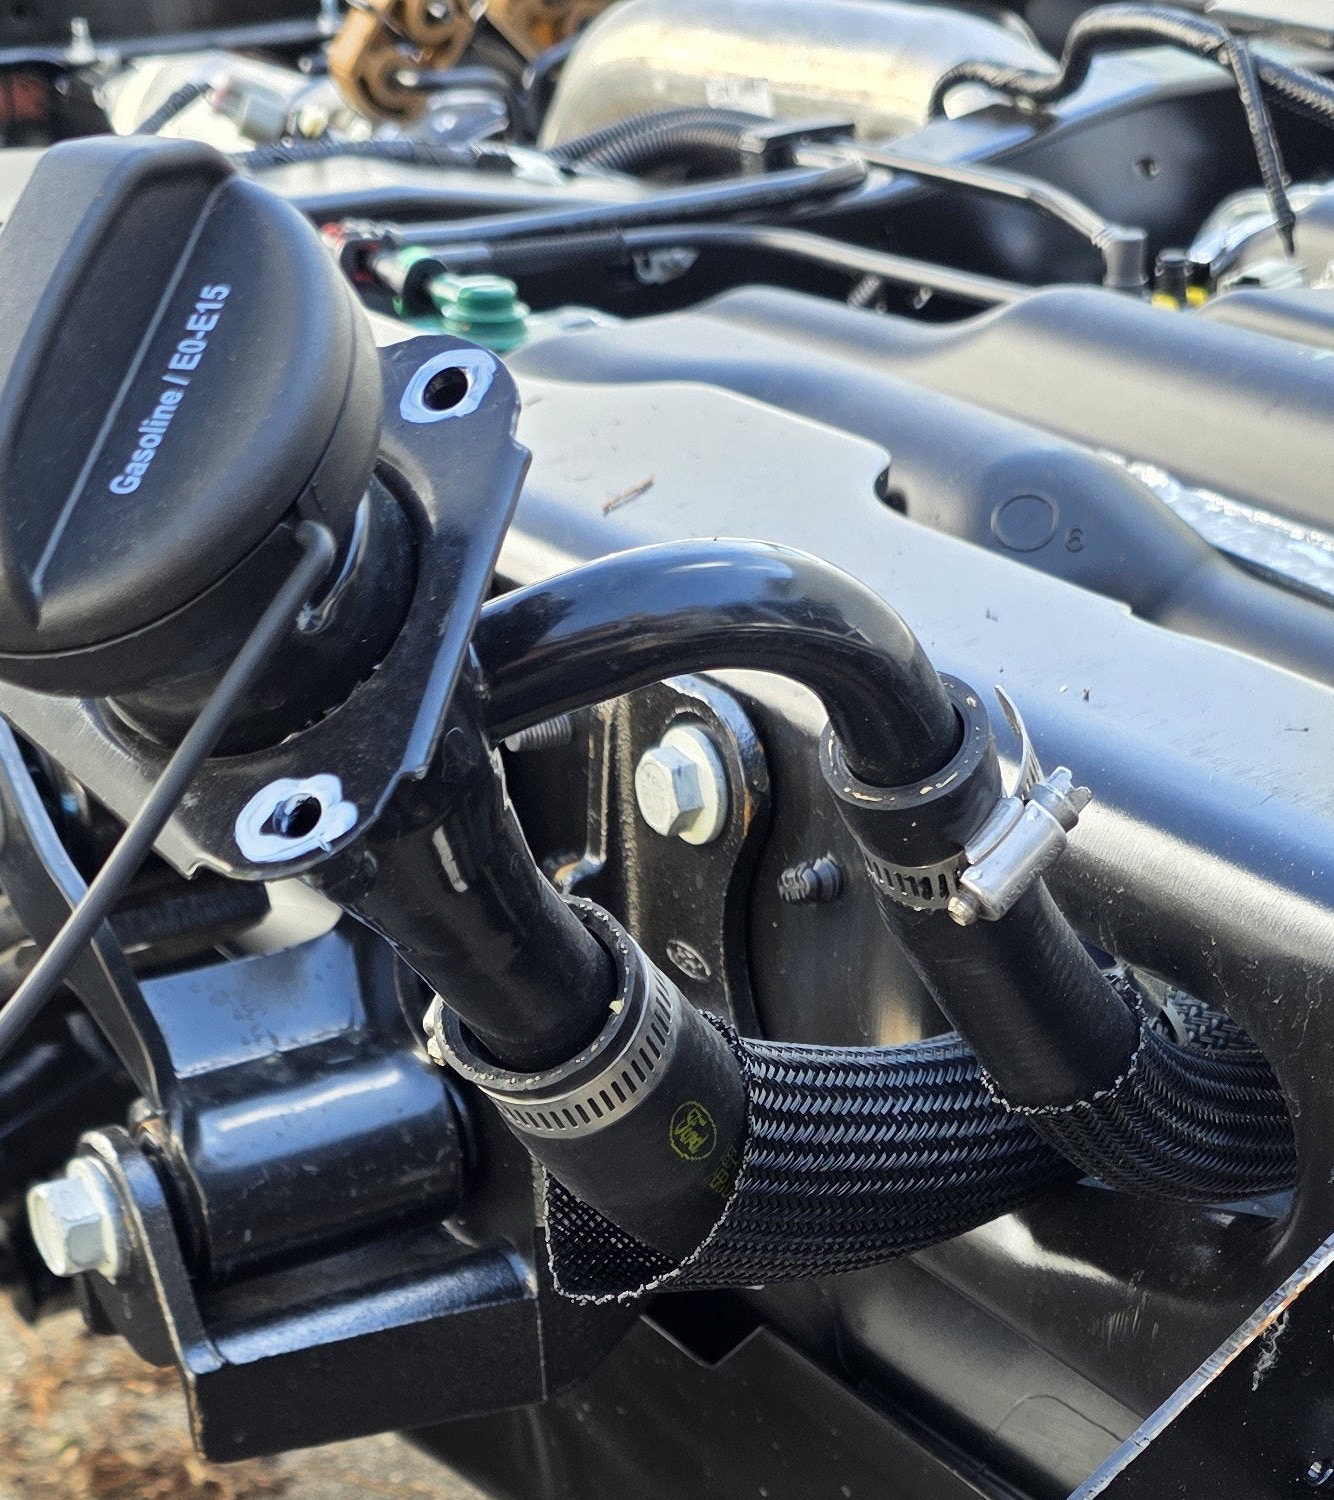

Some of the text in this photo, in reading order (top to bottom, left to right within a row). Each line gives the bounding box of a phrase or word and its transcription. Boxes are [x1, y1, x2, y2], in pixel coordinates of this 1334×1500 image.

[108, 283, 232, 495] Gasoline / E0-E15
